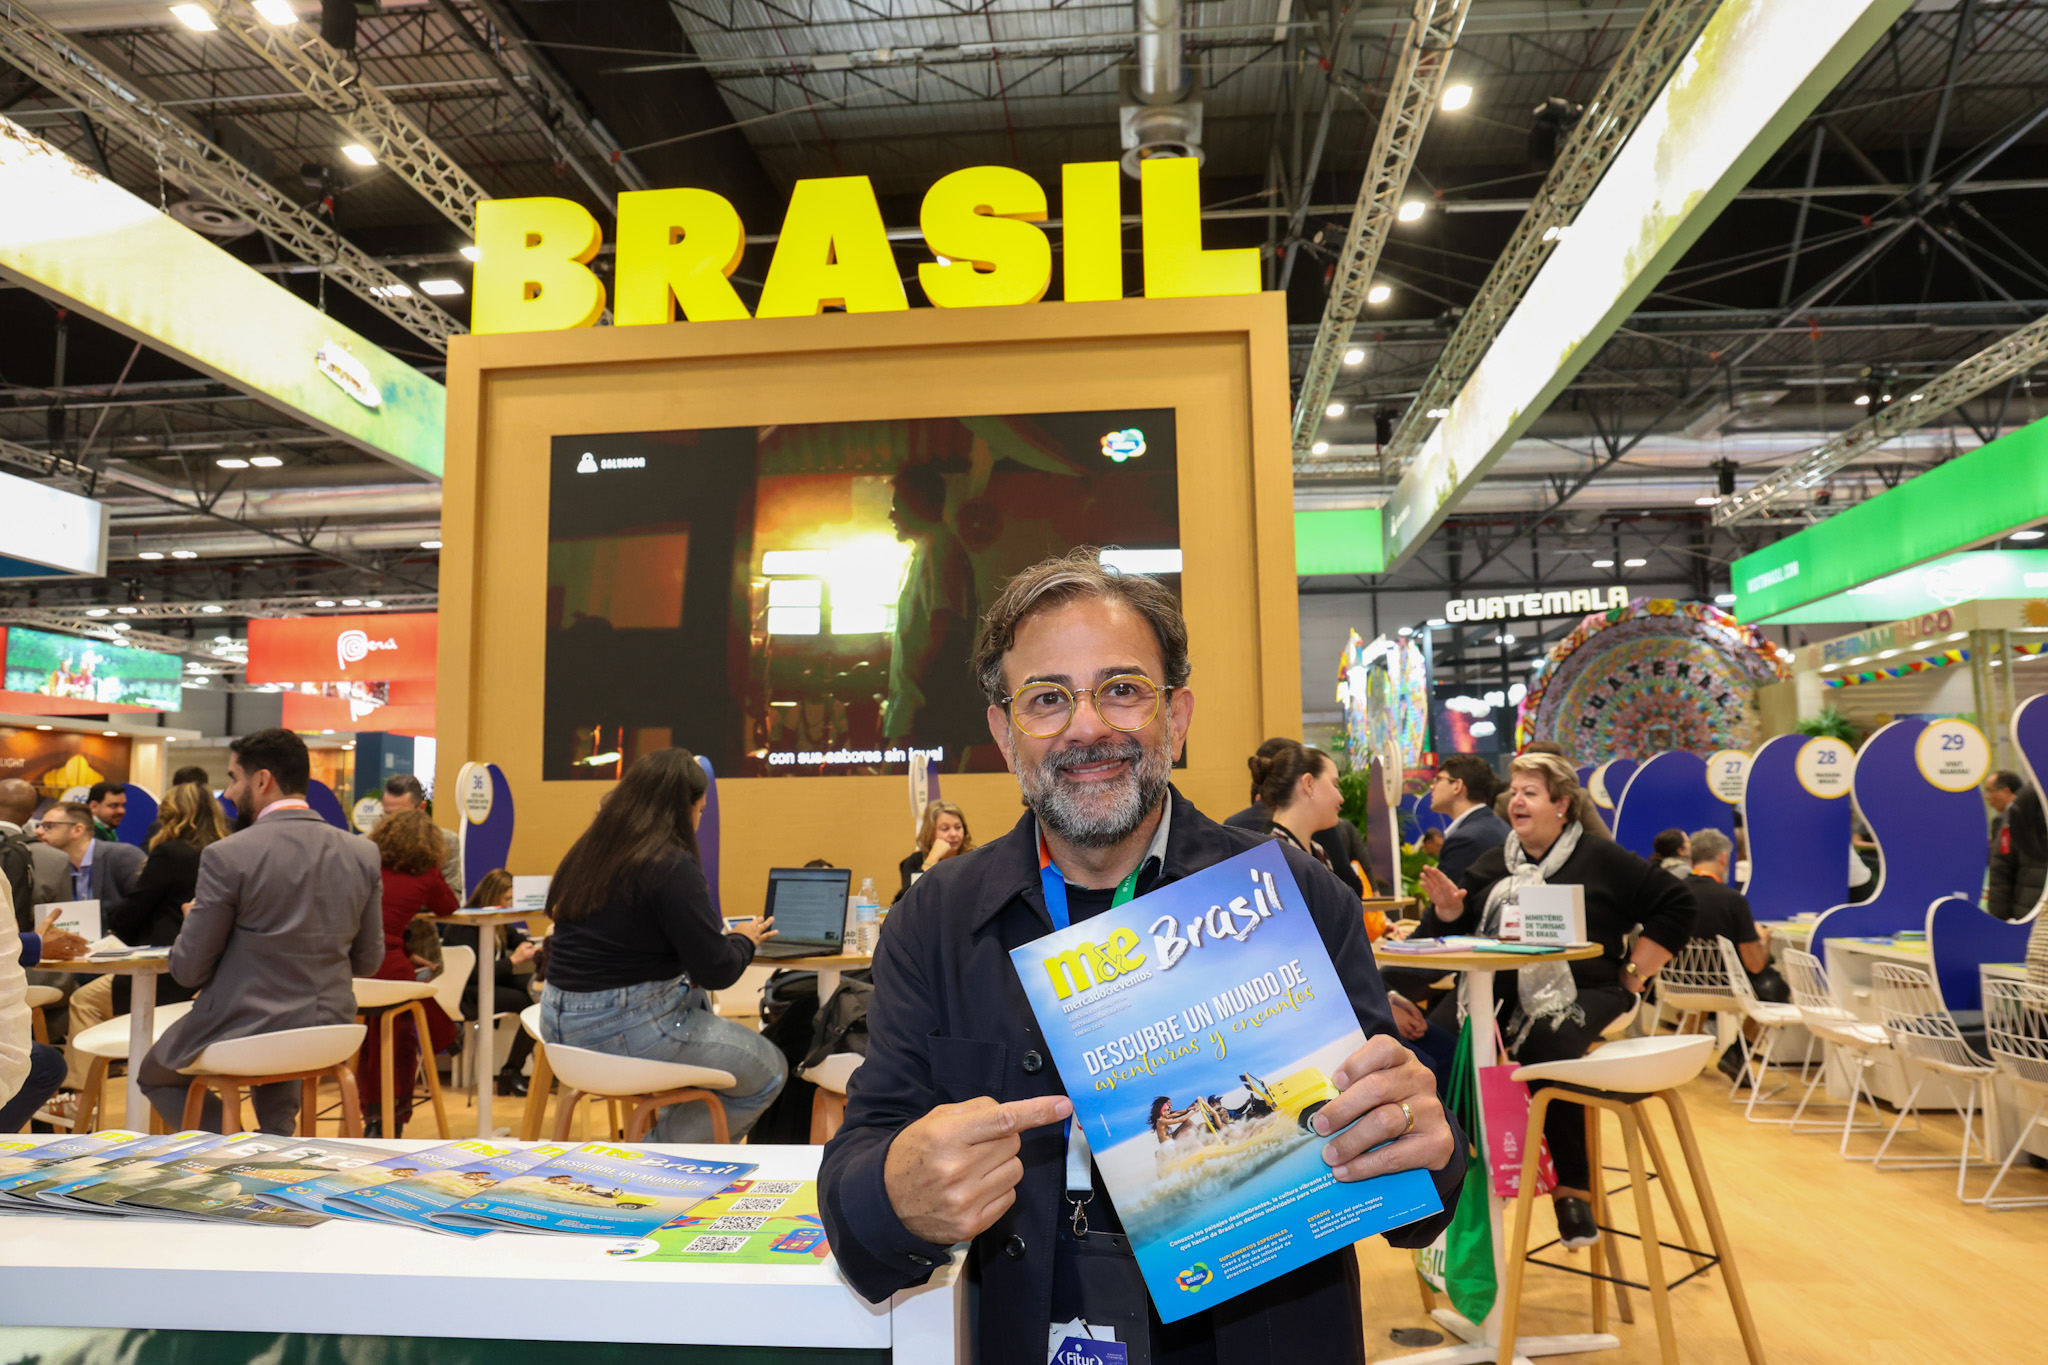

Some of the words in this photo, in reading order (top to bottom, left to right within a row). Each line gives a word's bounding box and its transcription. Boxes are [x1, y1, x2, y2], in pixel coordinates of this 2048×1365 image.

[471, 157, 1262, 335] BRASIL
[1446, 585, 1630, 623] GUATEMALA
[1941, 734, 1964, 750] 29
[769, 752, 795, 765] con
[885, 747, 906, 762] sin
[1816, 750, 1837, 765] 28
[1724, 761, 1742, 774] 27
[472, 775, 484, 790] 36
[1148, 868, 1284, 971] Brasil
[1062, 969, 1153, 1014] mercado&eventos
[1082, 1015, 1184, 1075] DESCUBRE
[1182, 1002, 1214, 1033] UN
[1212, 971, 1281, 1020] MUNDO
[1278, 959, 1307, 989] DE
[1095, 1038, 1200, 1091] aventuras
[1209, 1030, 1227, 1060] y
[1232, 985, 1315, 1033] encantos
[552, 1159, 619, 1174] DESCUBRE
[638, 1157, 739, 1174] Brasil
[1169, 1234, 1194, 1247] Conozca
[1204, 1219, 1228, 1234] paisajes
[1228, 1201, 1272, 1222] deslumbrantes,
[1278, 1188, 1298, 1200] cultura
[1299, 1178, 1322, 1190] vibrante
[1180, 1243, 1191, 1251] que
[1191, 1236, 1209, 1246] hacen
[1218, 1223, 1235, 1234] Brasil
[1244, 1211, 1265, 1223] destino
[1265, 1197, 1296, 1213] inolvidable
[1296, 1191, 1310, 1200] para
[1310, 1181, 1332, 1193] turistas
[1307, 1209, 1331, 1222] ESTADOS
[1314, 1228, 1335, 1239] destinos
[1219, 1243, 1256, 1262] SUPLEMENTOS
[1256, 1229, 1288, 1246] ESPECIALES
[1221, 1259, 1237, 1268] Ceará
[1186, 1273, 1205, 1284] BRASIL
[1067, 1352, 1095, 1365] Fitur
